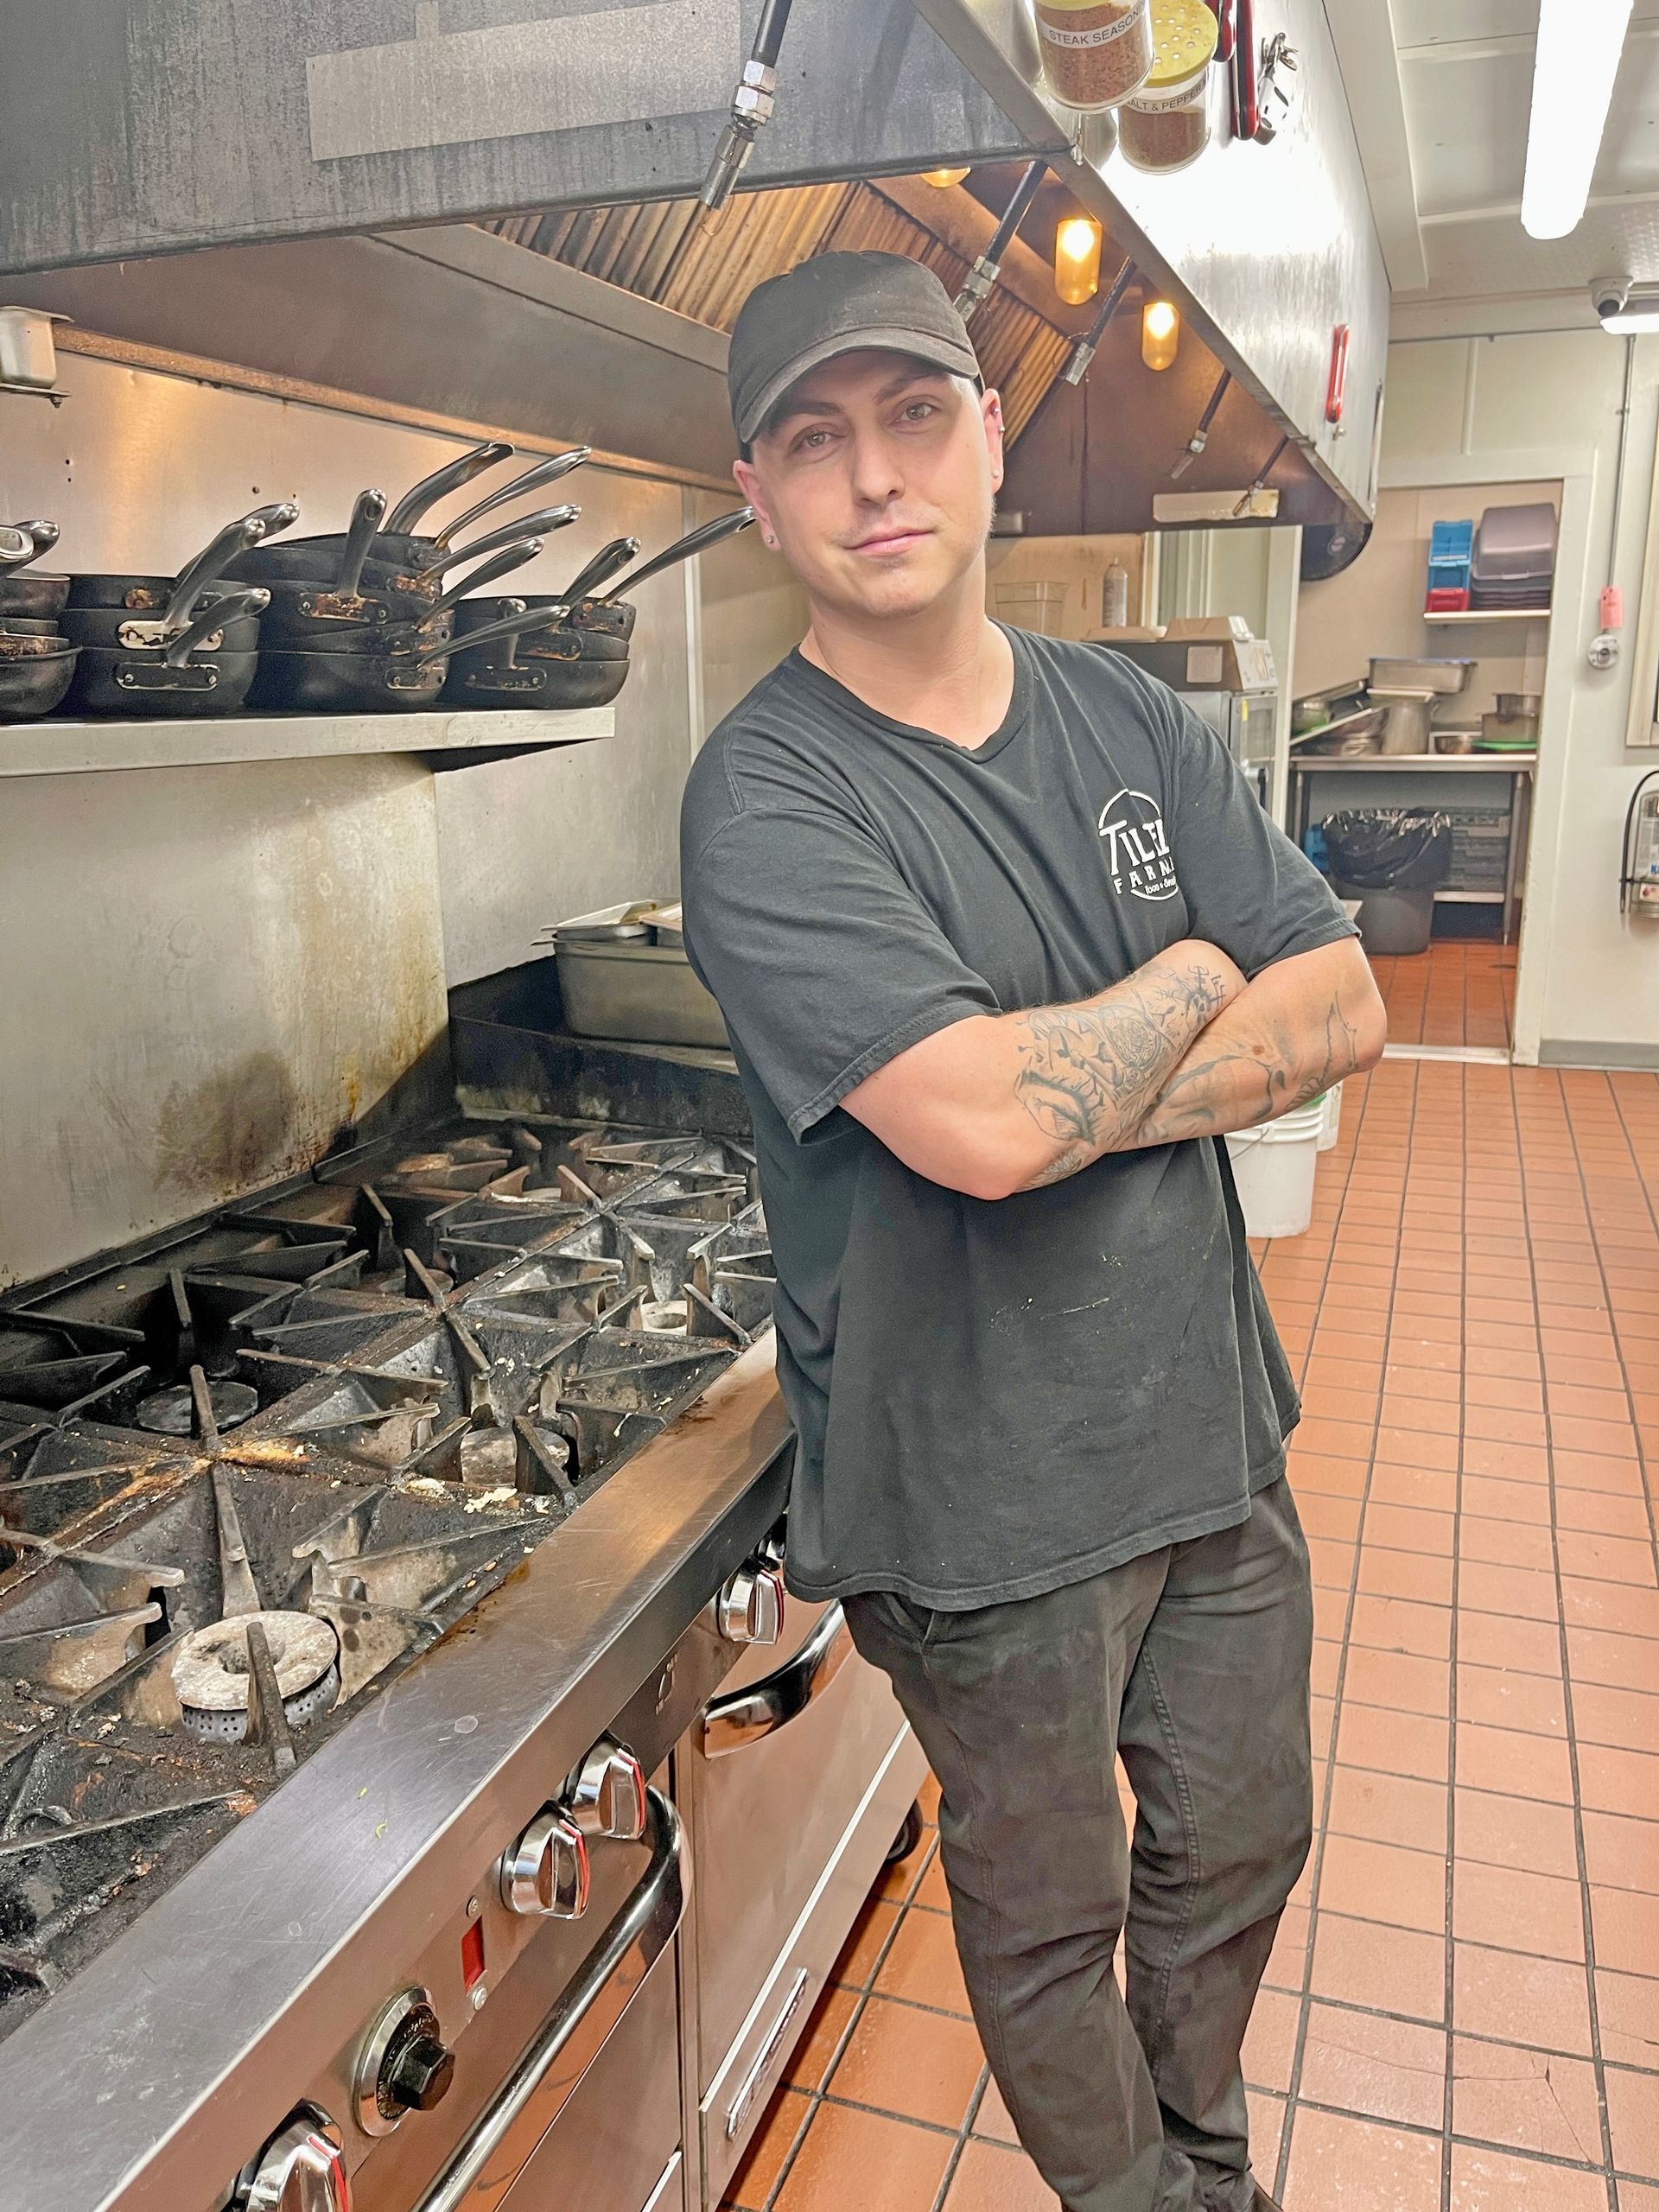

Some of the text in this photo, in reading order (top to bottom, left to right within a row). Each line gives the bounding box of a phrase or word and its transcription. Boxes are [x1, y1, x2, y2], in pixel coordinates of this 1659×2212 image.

[1048, 29, 1090, 45] STEAK
[1151, 103, 1159, 111] &
[1161, 84, 1202, 111] PEPPER
